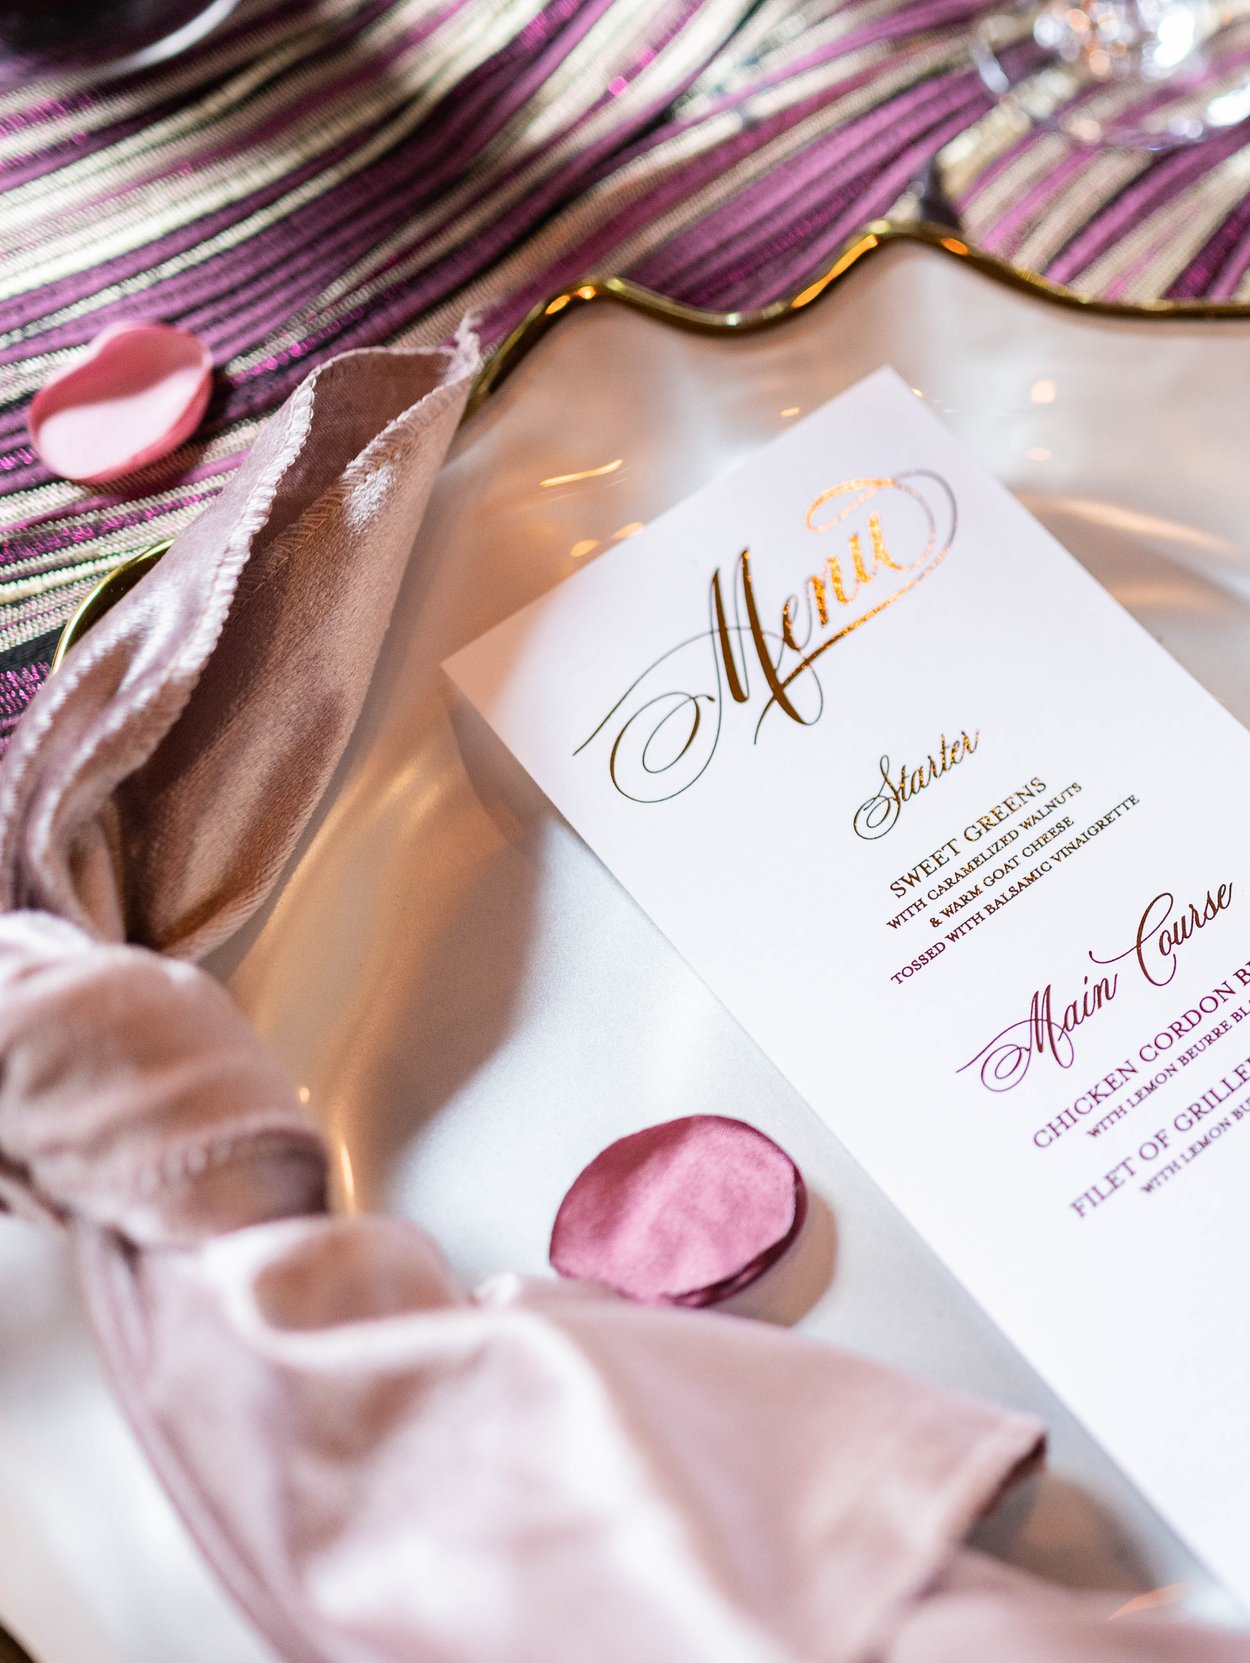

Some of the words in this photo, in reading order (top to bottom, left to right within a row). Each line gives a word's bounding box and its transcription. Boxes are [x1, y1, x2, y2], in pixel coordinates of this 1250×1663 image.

[573, 468, 957, 803] Menu
[853, 729, 979, 840] Starter
[890, 838, 963, 898] SWEET
[963, 777, 1047, 842] GREENS
[886, 898, 927, 930] WITH
[927, 829, 1019, 900] CARAMELIZED
[1018, 782, 1082, 830] WALNUTS
[890, 941, 946, 985] TOSSED
[944, 912, 985, 943] WITH
[983, 861, 1053, 916] BALSAMIC
[1050, 794, 1140, 863] VINAIGRETTE
[929, 917, 943, 928] &
[940, 884, 984, 917] WARM
[983, 855, 1021, 887] GOAT
[1022, 816, 1075, 857] CHEESE
[956, 973, 1118, 1092] Main
[1089, 882, 1234, 987] Course
[1033, 1060, 1139, 1148] CHICKEN
[1139, 980, 1236, 1062] CORDON
[1086, 1106, 1128, 1138] WITH
[1127, 1063, 1178, 1108] LEMON
[1177, 1020, 1232, 1066] BEURRE
[1070, 1157, 1136, 1218] FILET
[1139, 1129, 1170, 1160] OF
[1140, 1160, 1181, 1194] WITH
[1180, 1118, 1231, 1164] LEMON
